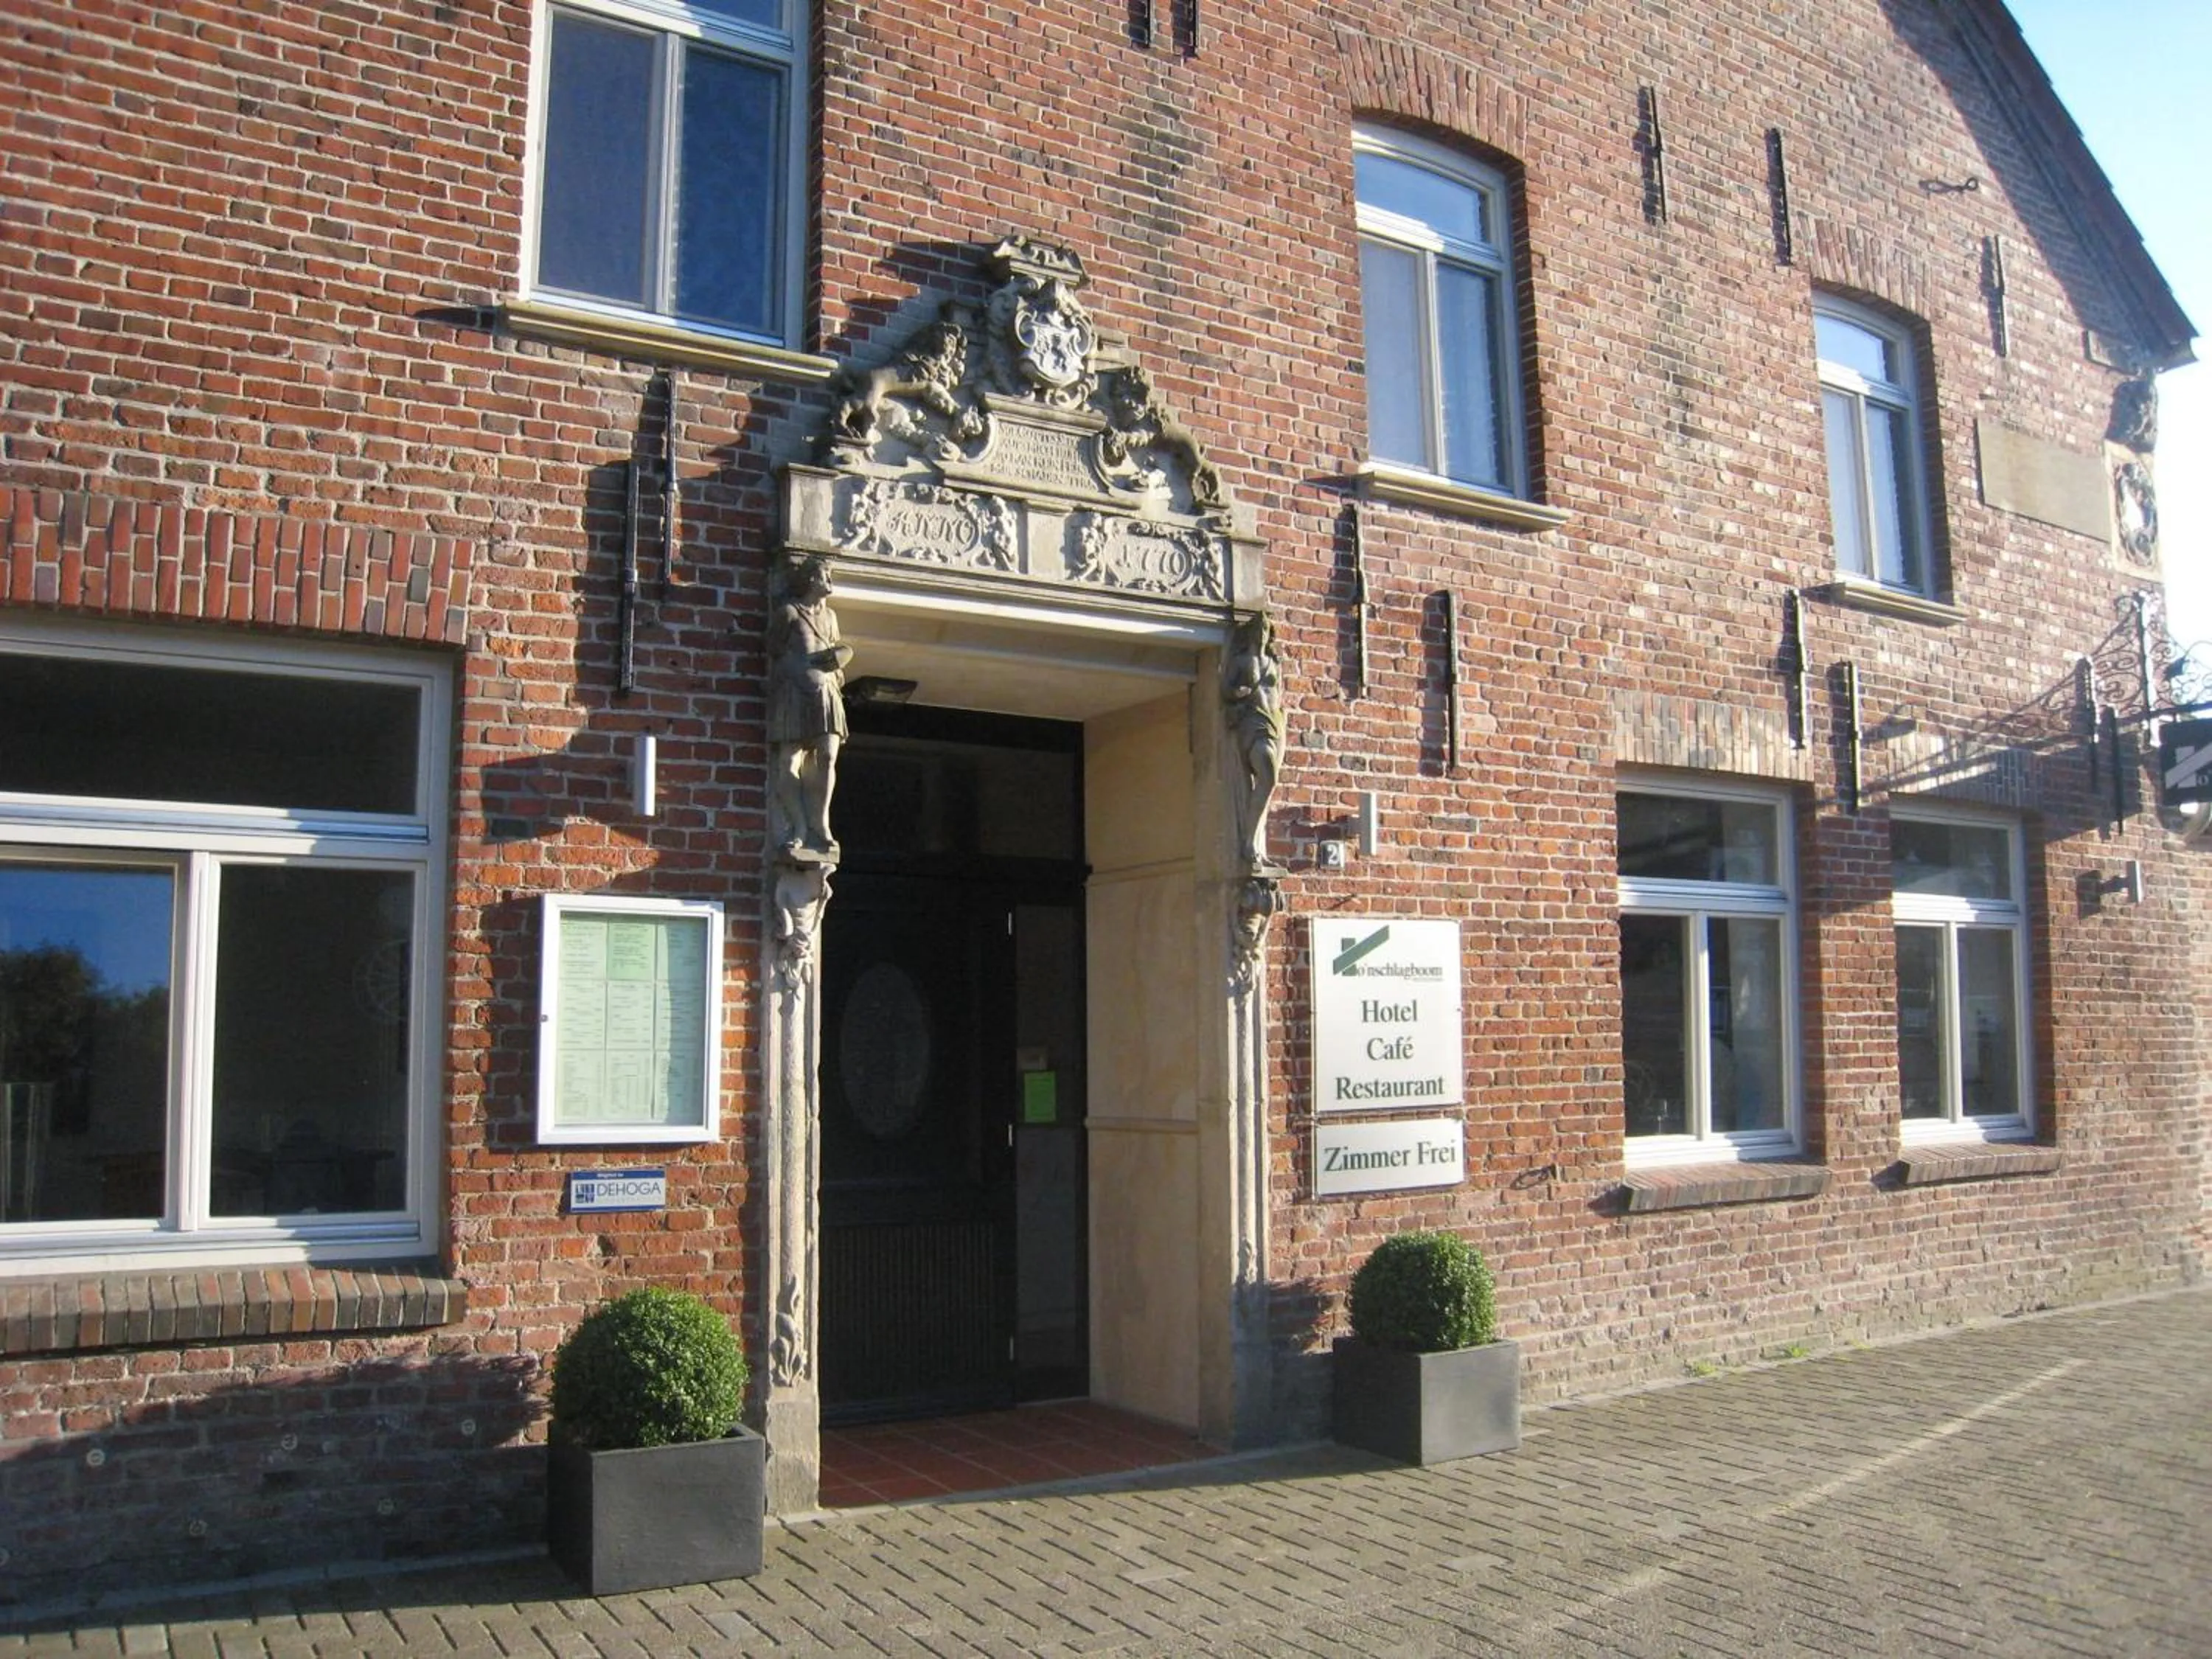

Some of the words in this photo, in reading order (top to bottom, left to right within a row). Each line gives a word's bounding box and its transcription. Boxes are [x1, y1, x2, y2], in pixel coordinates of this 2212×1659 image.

[889, 512, 974, 545] ANNO
[1116, 544, 1187, 577] 1770
[1328, 844, 1340, 864] 2
[1361, 999, 1417, 1023] Hotel
[1367, 1036, 1414, 1061] Café
[1335, 1075, 1444, 1099] Restaurant
[1324, 1146, 1411, 1172] Zimmer
[1417, 1139, 1456, 1165] Frei
[597, 1182, 661, 1196] DEHOGA
